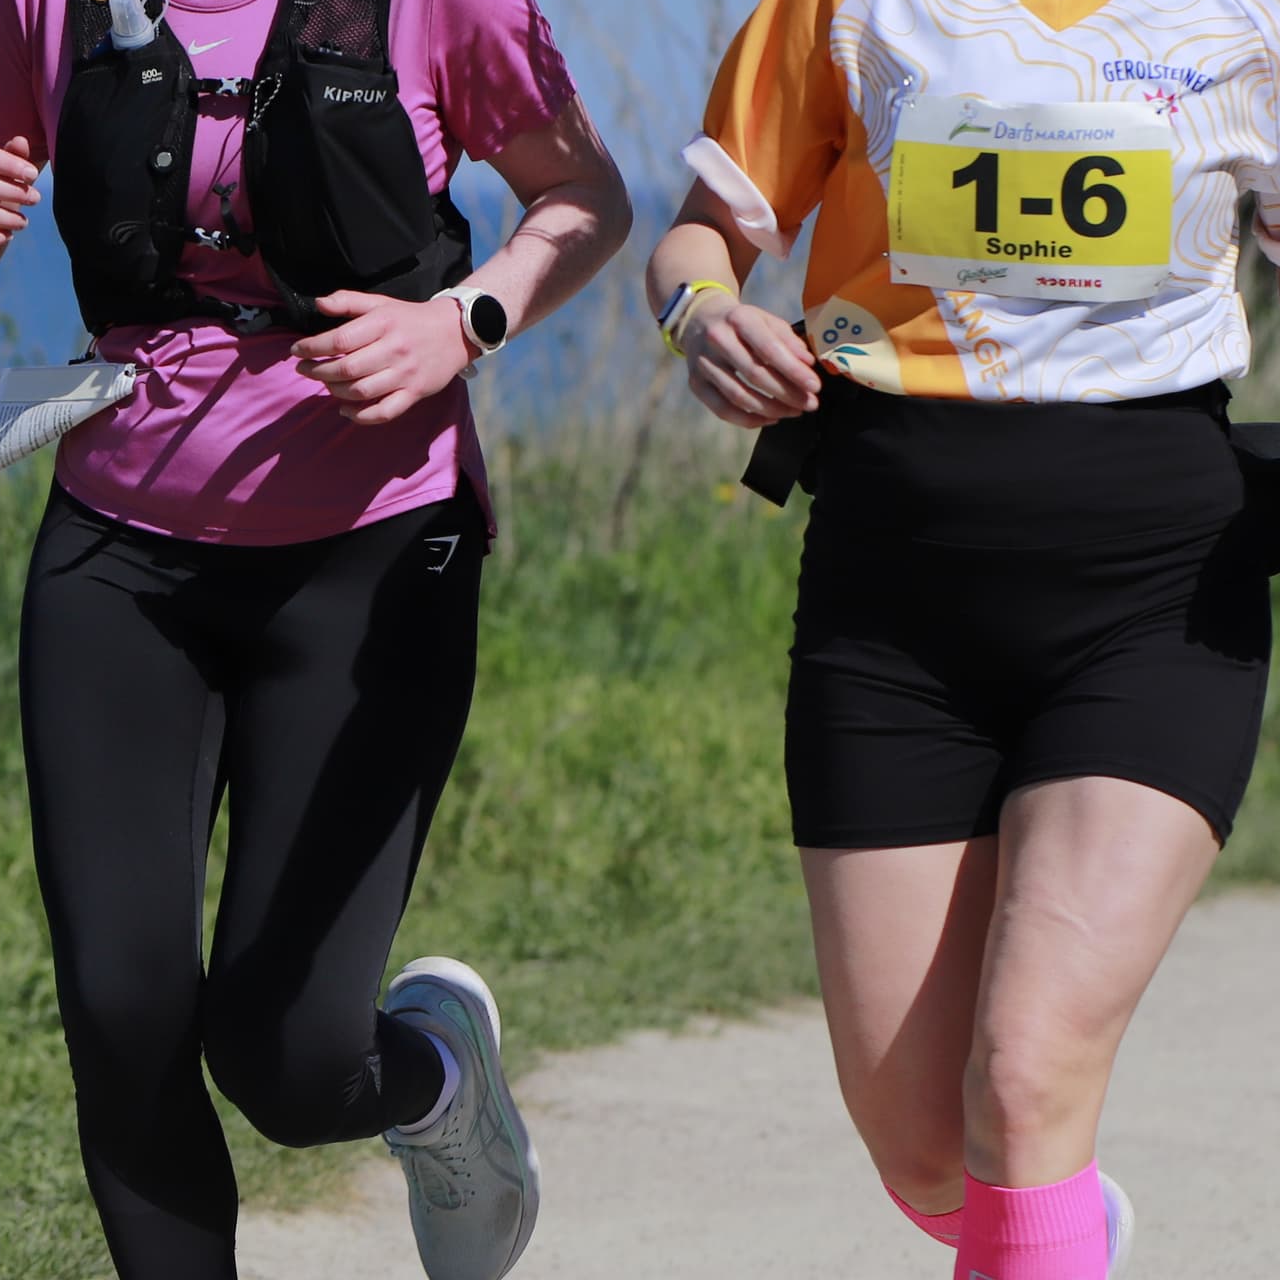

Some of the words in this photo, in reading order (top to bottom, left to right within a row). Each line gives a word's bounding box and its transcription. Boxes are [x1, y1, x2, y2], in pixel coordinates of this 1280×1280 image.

[323, 85, 387, 103] KIPRUN
[952, 151, 1128, 238] 1-6
[986, 237, 1073, 260] Sophie
